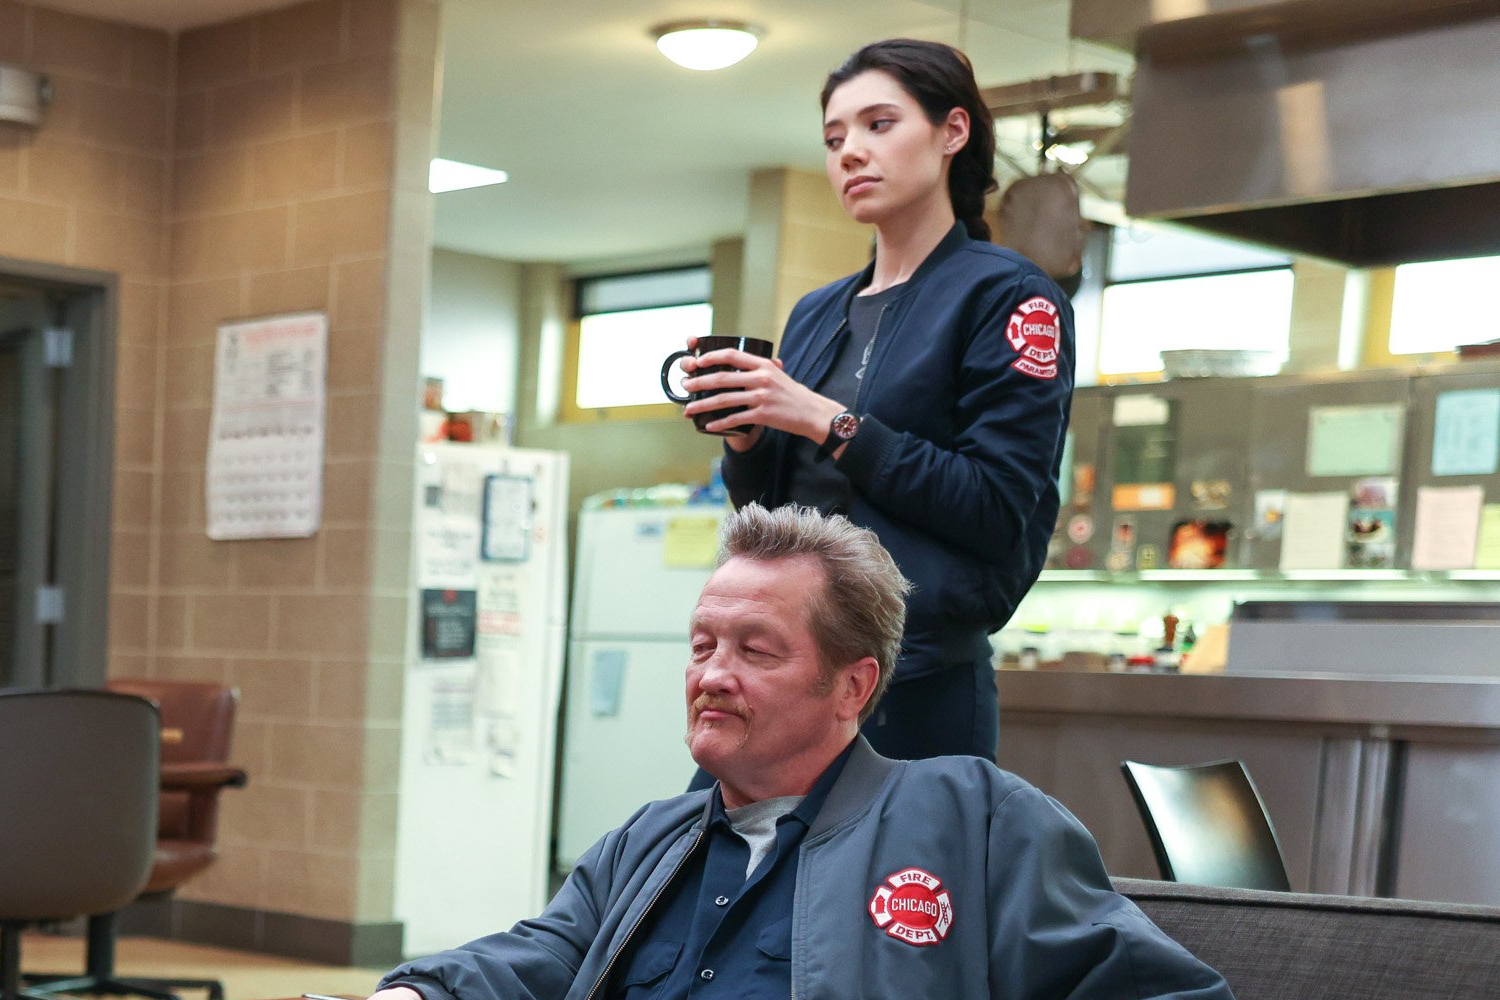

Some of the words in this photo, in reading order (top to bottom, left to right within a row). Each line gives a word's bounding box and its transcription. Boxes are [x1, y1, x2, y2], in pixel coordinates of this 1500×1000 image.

[1028, 301, 1051, 312] FIRE
[1023, 323, 1055, 338] CHICAGO
[1019, 362, 1056, 376] PARAMED
[900, 873, 931, 886] FIRE
[891, 898, 937, 917] CHICAGO
[895, 926, 933, 940] DEPT.
